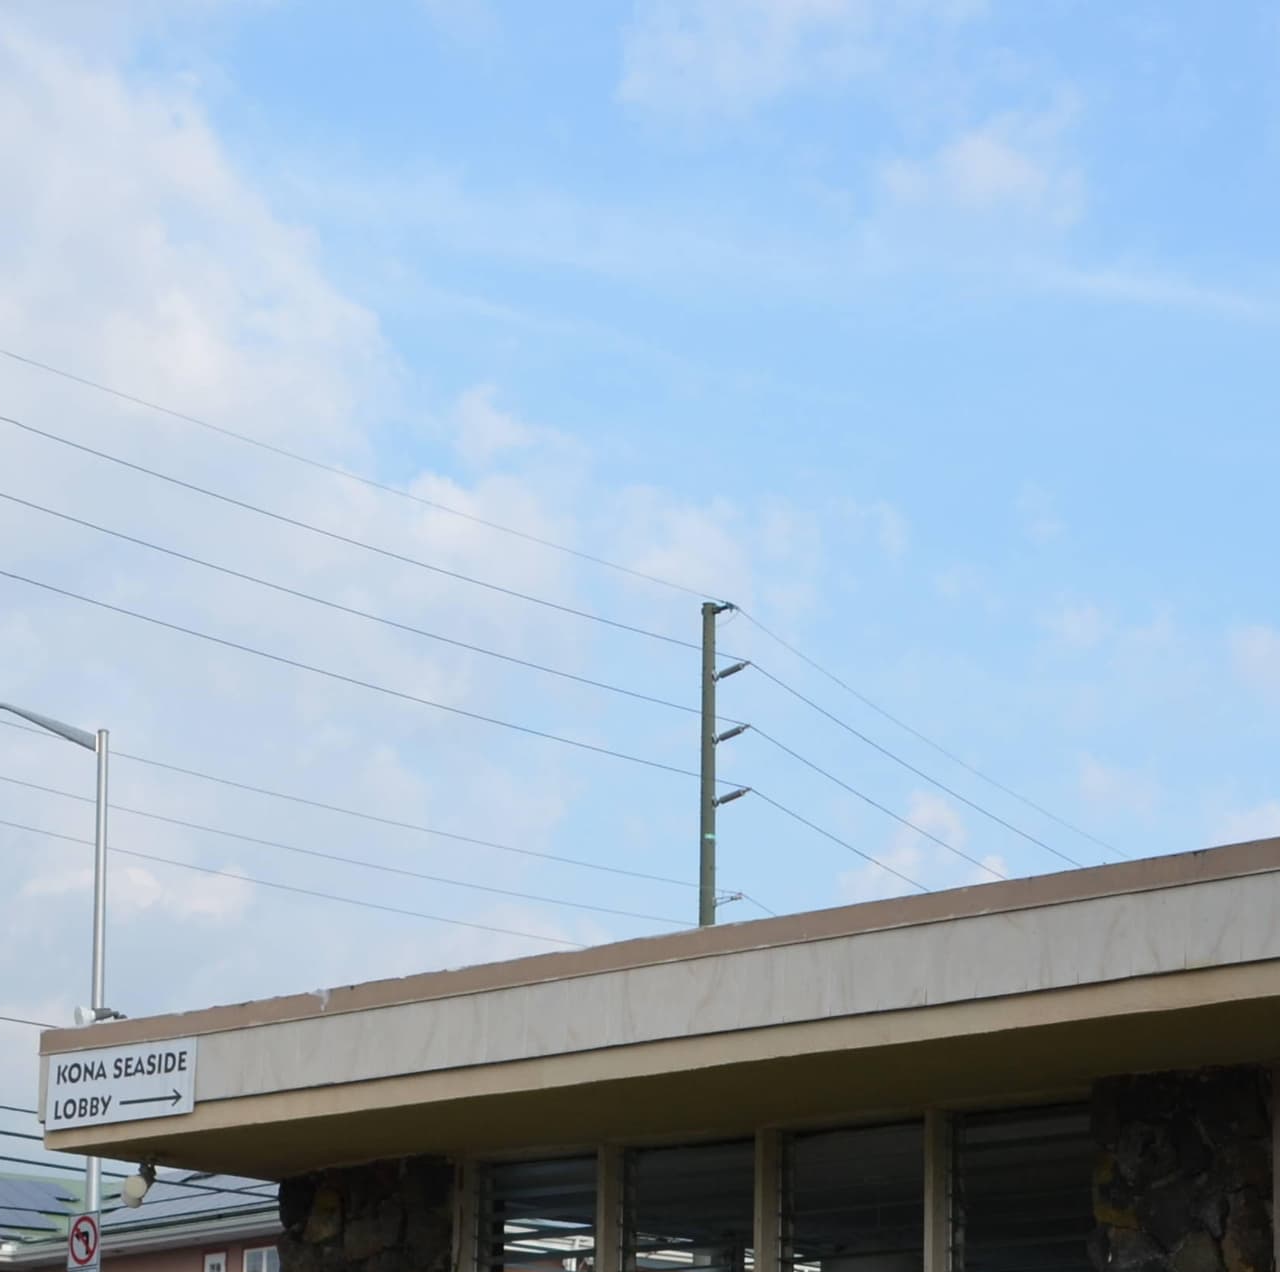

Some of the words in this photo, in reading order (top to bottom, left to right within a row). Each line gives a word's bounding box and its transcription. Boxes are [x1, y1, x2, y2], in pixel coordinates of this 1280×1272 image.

[56, 1060, 107, 1085] KONA
[113, 1051, 188, 1079] SEASIDE
[54, 1095, 112, 1120] LOBBY
